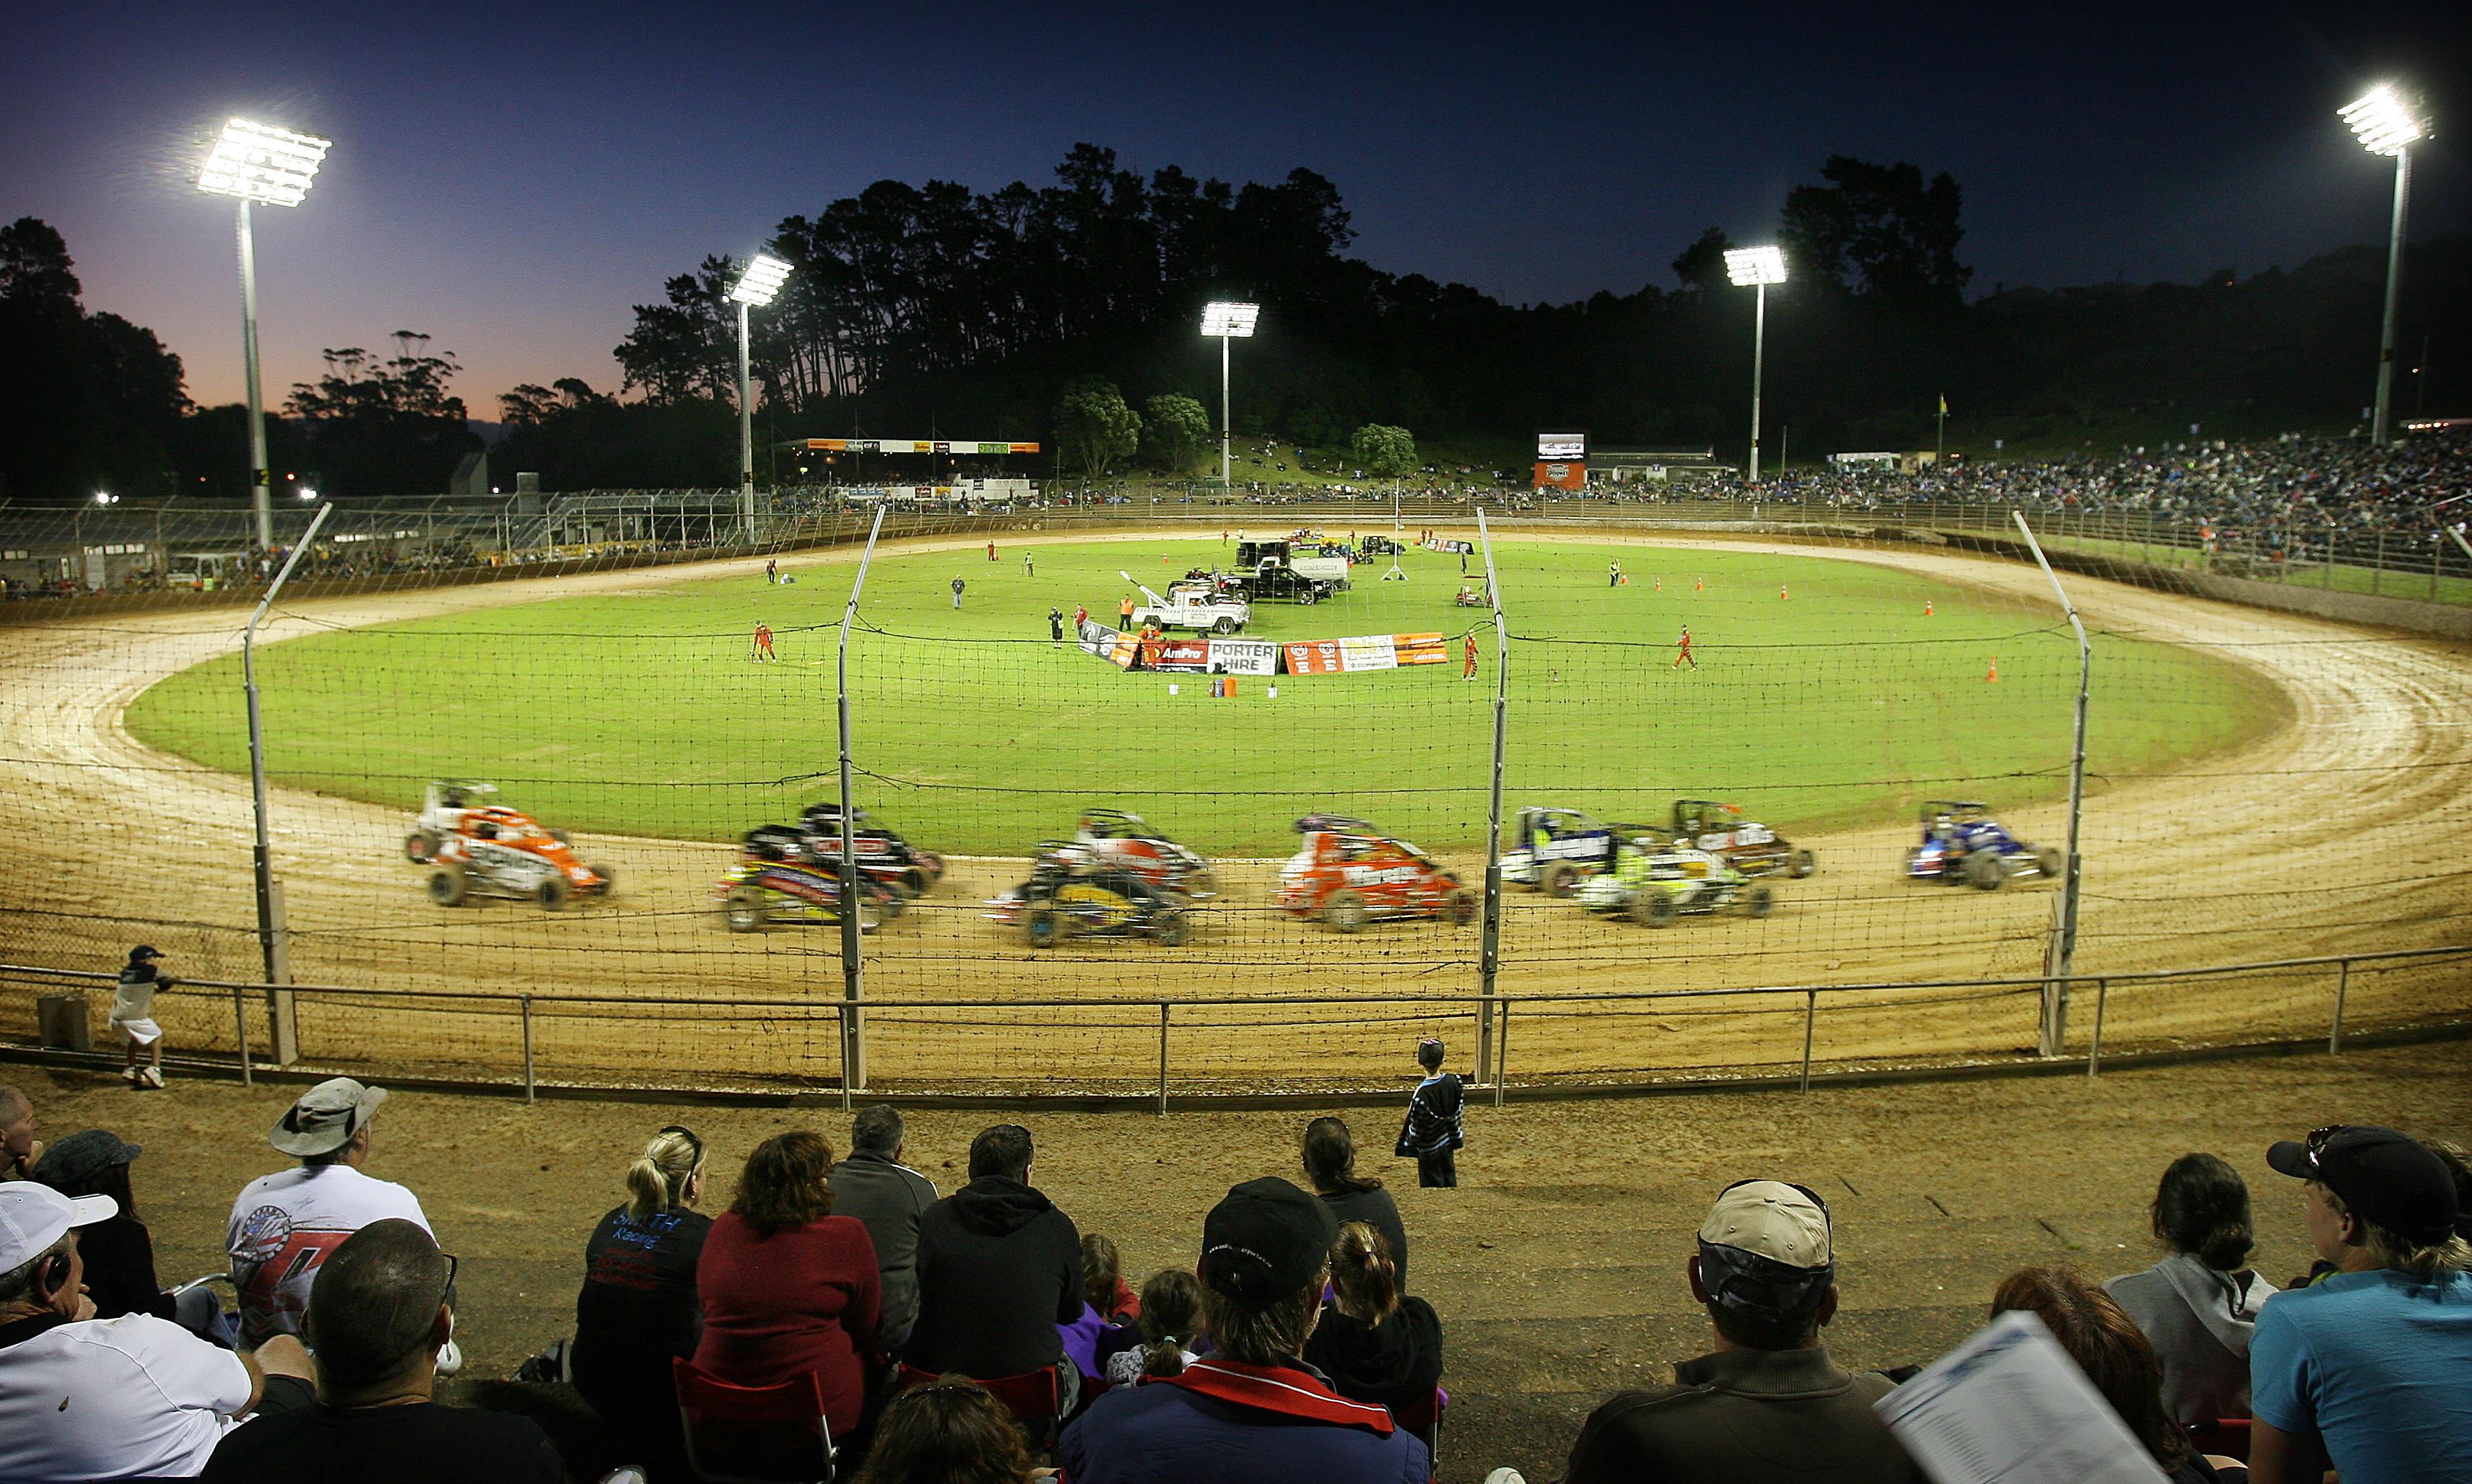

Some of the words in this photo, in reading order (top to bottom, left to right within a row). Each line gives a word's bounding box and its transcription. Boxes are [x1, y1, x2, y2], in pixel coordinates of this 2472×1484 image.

[260, 469, 270, 485] 2
[1162, 647, 1204, 659] AmPro
[1212, 645, 1274, 657] PORTER
[1224, 658, 1260, 670] HIRE
[612, 1213, 682, 1231] STH
[612, 1227, 662, 1249] Racing
